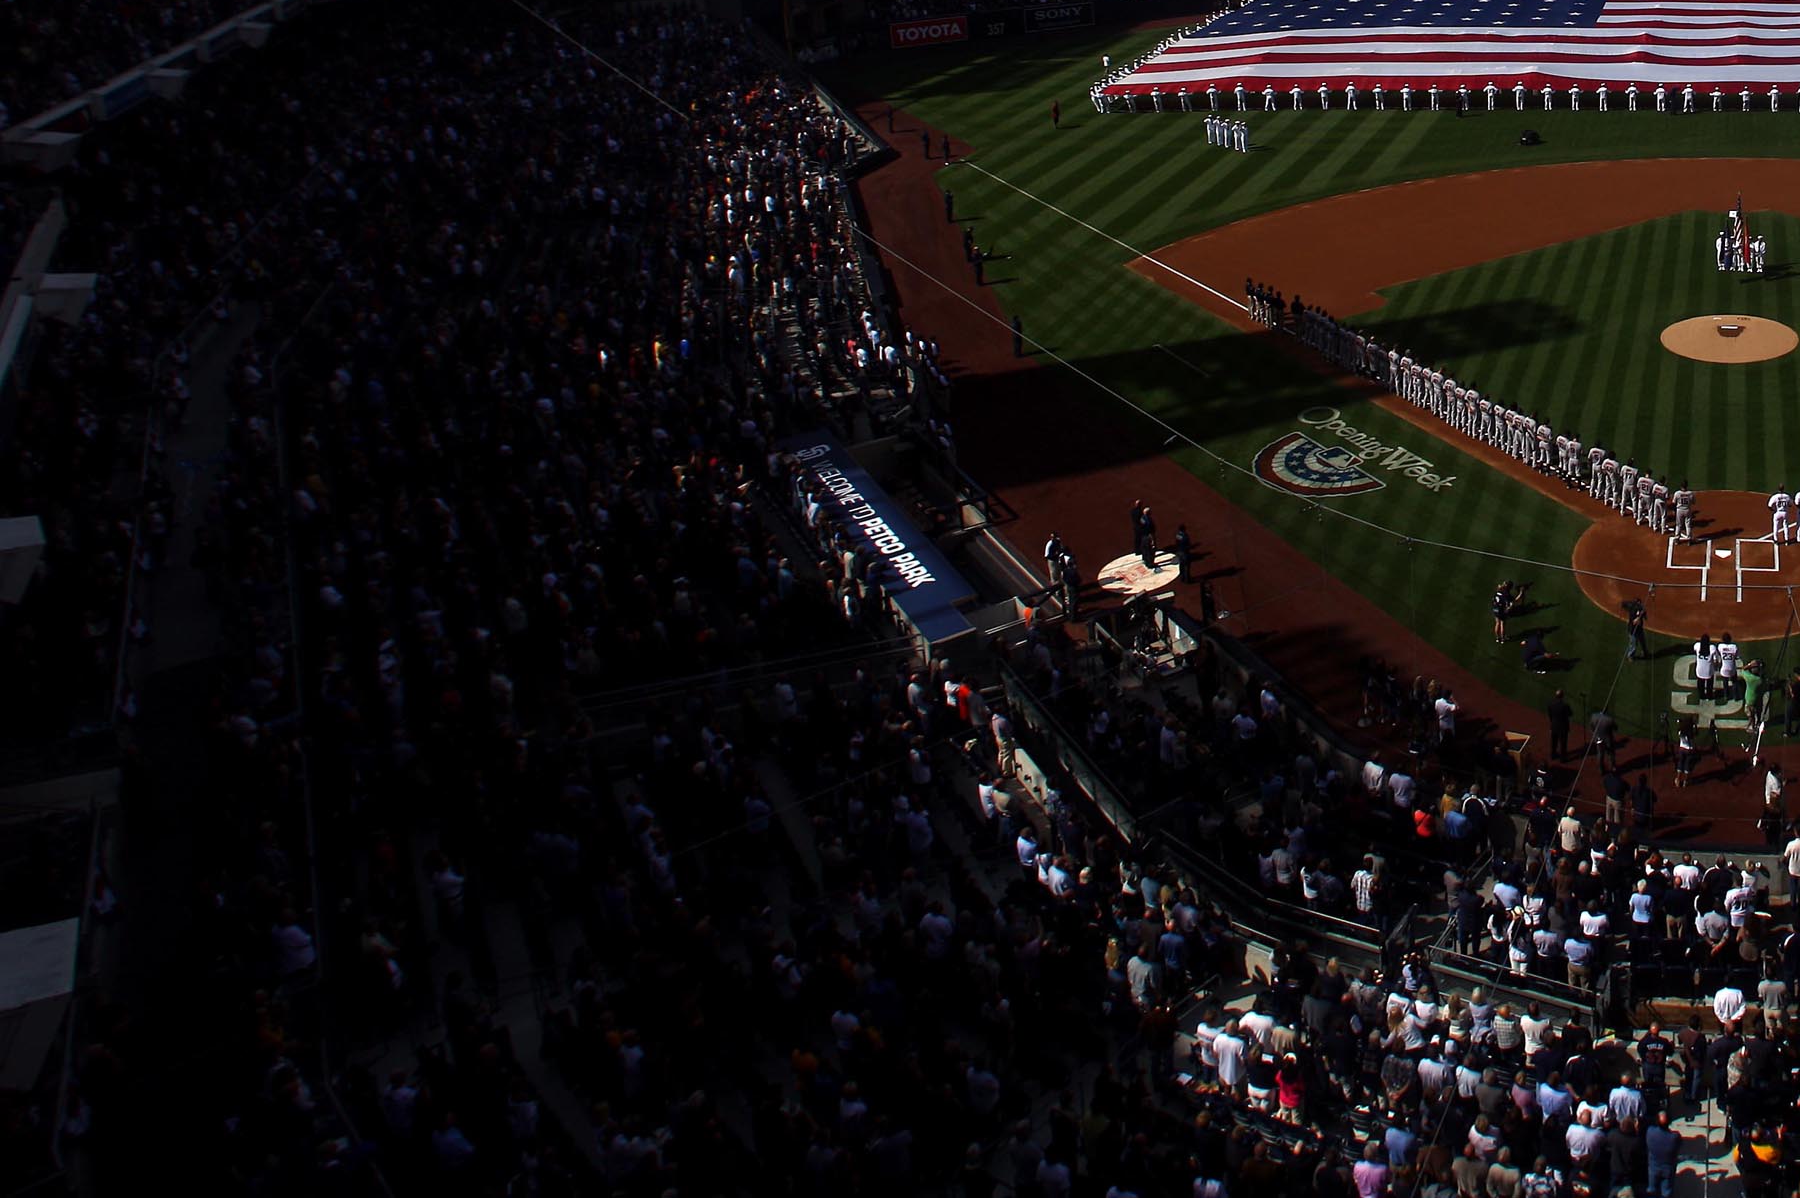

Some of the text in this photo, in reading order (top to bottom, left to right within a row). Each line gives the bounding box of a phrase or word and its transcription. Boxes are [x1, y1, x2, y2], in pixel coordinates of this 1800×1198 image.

[1033, 4, 1084, 21] SONY
[895, 20, 964, 43] TOYOTA
[1298, 406, 1457, 492] Opening Week
[811, 459, 864, 505] WELCOME
[849, 503, 876, 526] TO
[863, 516, 906, 555] PETCO
[889, 551, 936, 588] PARK
[1722, 652, 1733, 661] 23
